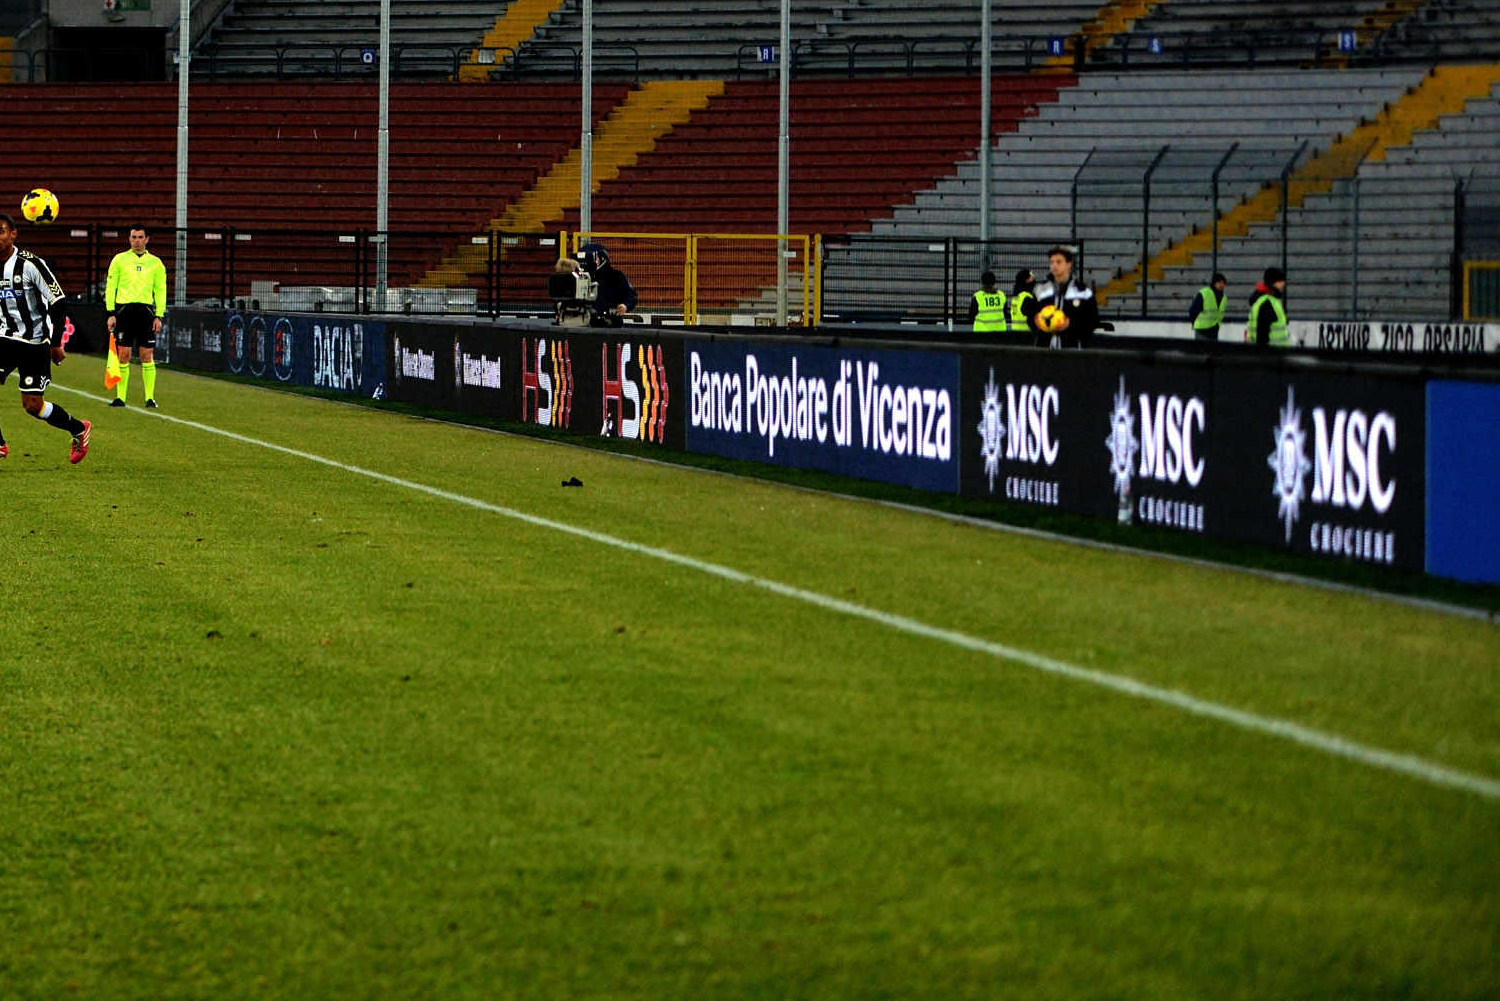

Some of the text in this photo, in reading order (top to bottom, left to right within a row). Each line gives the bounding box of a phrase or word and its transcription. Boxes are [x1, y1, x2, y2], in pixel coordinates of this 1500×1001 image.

[984, 296, 1002, 307] 183
[313, 325, 354, 389] DACIA
[522, 337, 553, 426] HS
[602, 342, 641, 439] HS
[690, 351, 951, 461] Banca Popolare di Vicenza
[1005, 383, 1059, 466] MSC
[1138, 392, 1205, 487] MSC
[1311, 406, 1396, 514] MSC
